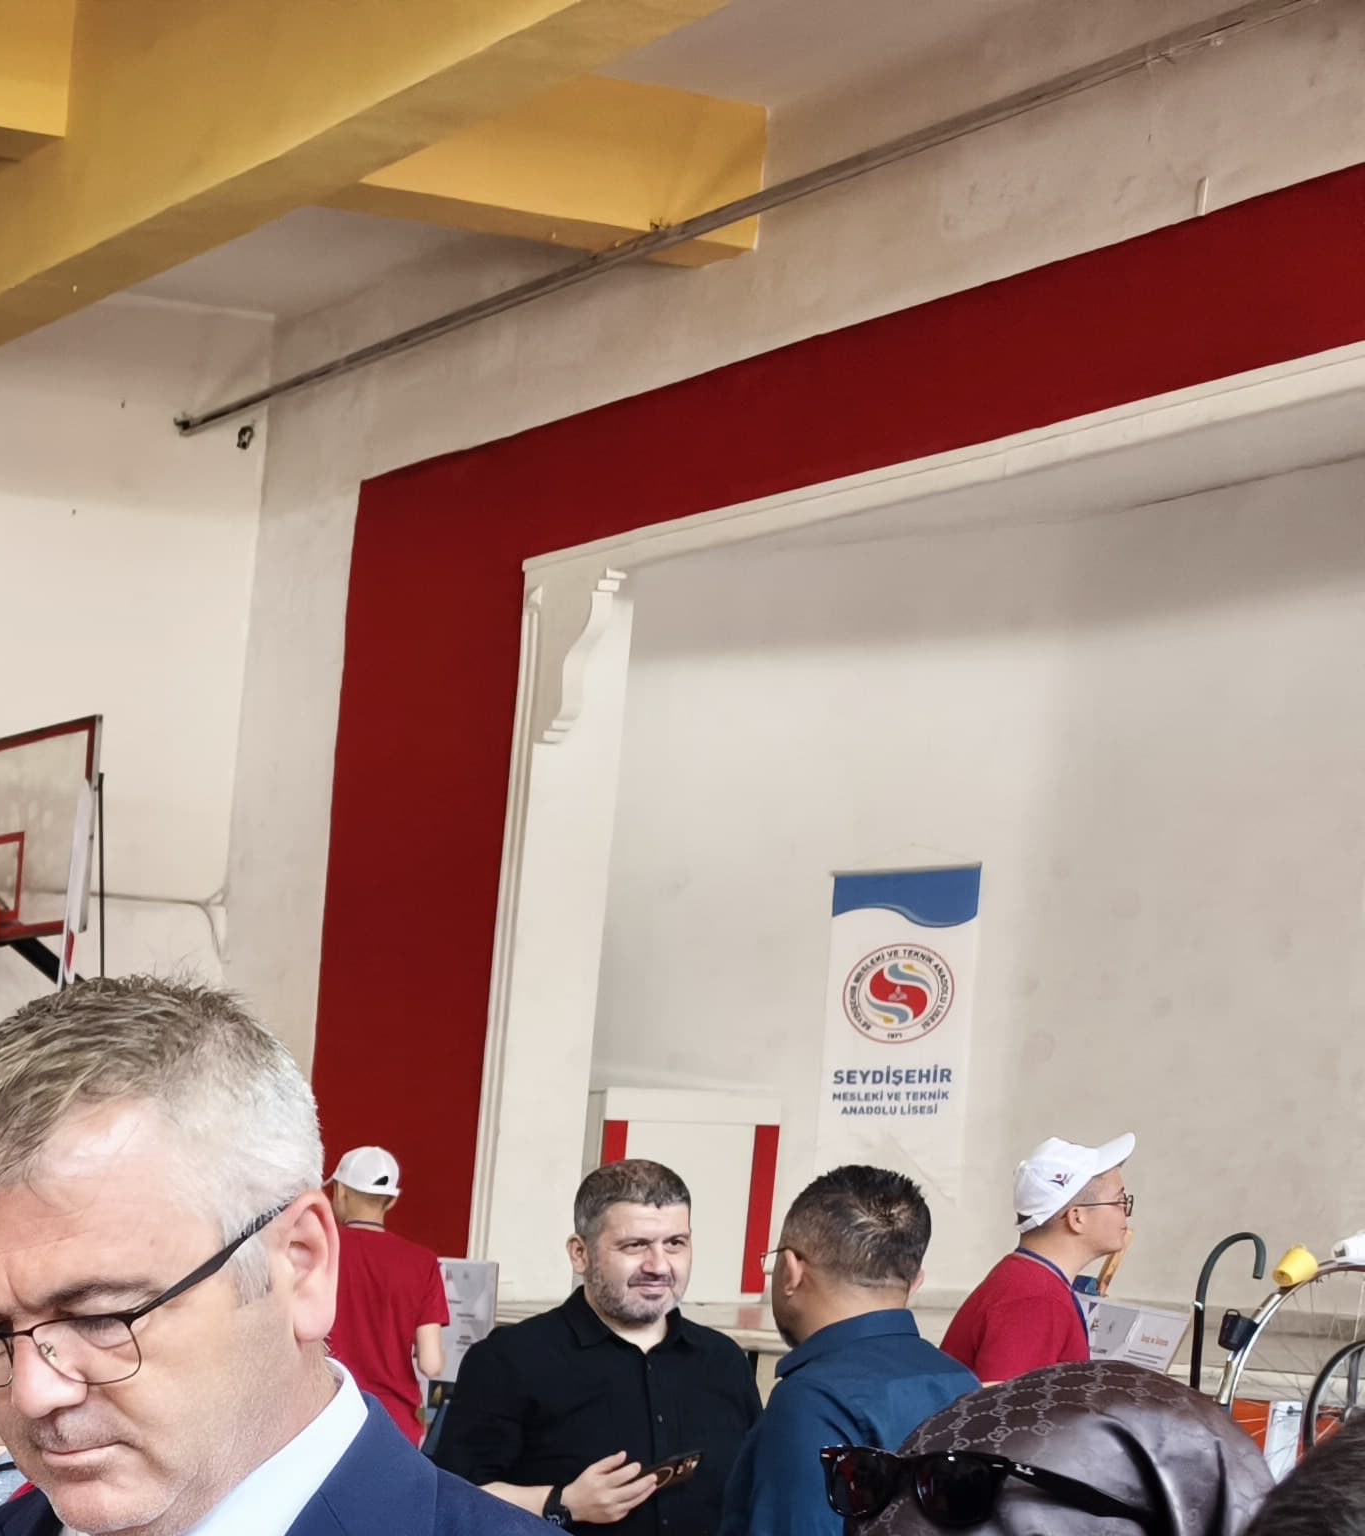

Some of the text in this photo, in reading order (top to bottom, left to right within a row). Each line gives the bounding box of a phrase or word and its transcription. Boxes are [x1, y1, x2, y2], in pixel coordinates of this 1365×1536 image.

[886, 950, 899, 958] VE
[832, 1064, 952, 1086] SEYDİŞEHİR
[832, 1089, 949, 1102] MESLEKİ VE TEKNİK
[841, 1103, 937, 1115] ANADOLU LİSESİ
